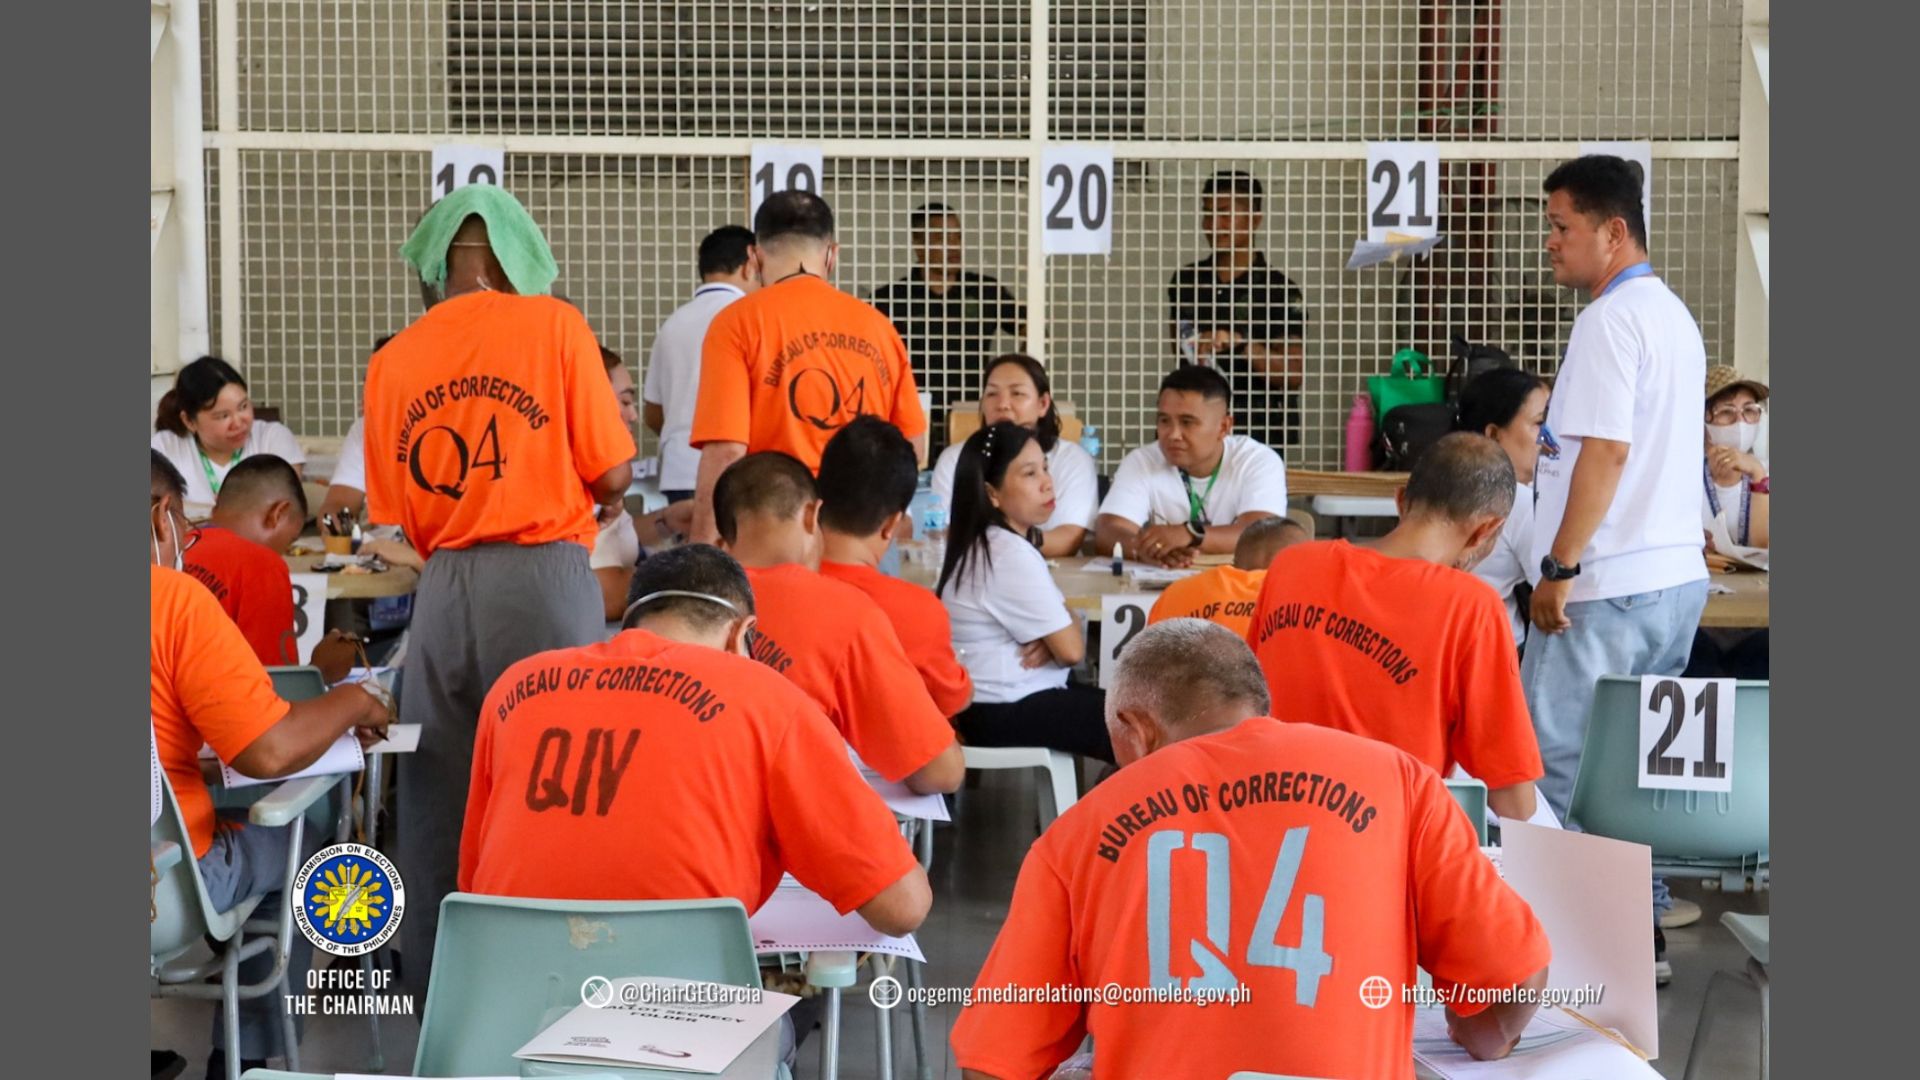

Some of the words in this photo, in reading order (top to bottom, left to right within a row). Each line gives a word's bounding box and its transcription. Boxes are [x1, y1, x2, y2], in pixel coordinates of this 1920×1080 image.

[1046, 164, 1107, 230] 20
[1372, 160, 1432, 227] 21
[803, 332, 819, 350] OF
[425, 384, 446, 410] OF
[449, 375, 549, 430] CORRECTIONS
[789, 368, 868, 430] Q4
[409, 413, 507, 500] Q4
[1203, 602, 1221, 619] OF
[1304, 605, 1325, 630] OF
[1325, 612, 1418, 684] CORRECTIONS
[497, 667, 561, 722] BUREAU
[567, 668, 593, 690] OF
[596, 665, 725, 722] CORRECTIONS
[1647, 680, 1726, 778] 21
[525, 727, 641, 817] QIV
[1097, 788, 1178, 863] BUREAU
[1182, 784, 1210, 813] OF
[1219, 772, 1376, 833] CORRECTIONS
[1147, 826, 1333, 1008] Q4
[602, 1004, 659, 1013] ALLOT
[666, 1009, 745, 1023] SECRECY
[630, 1011, 698, 1022] FOLDER
